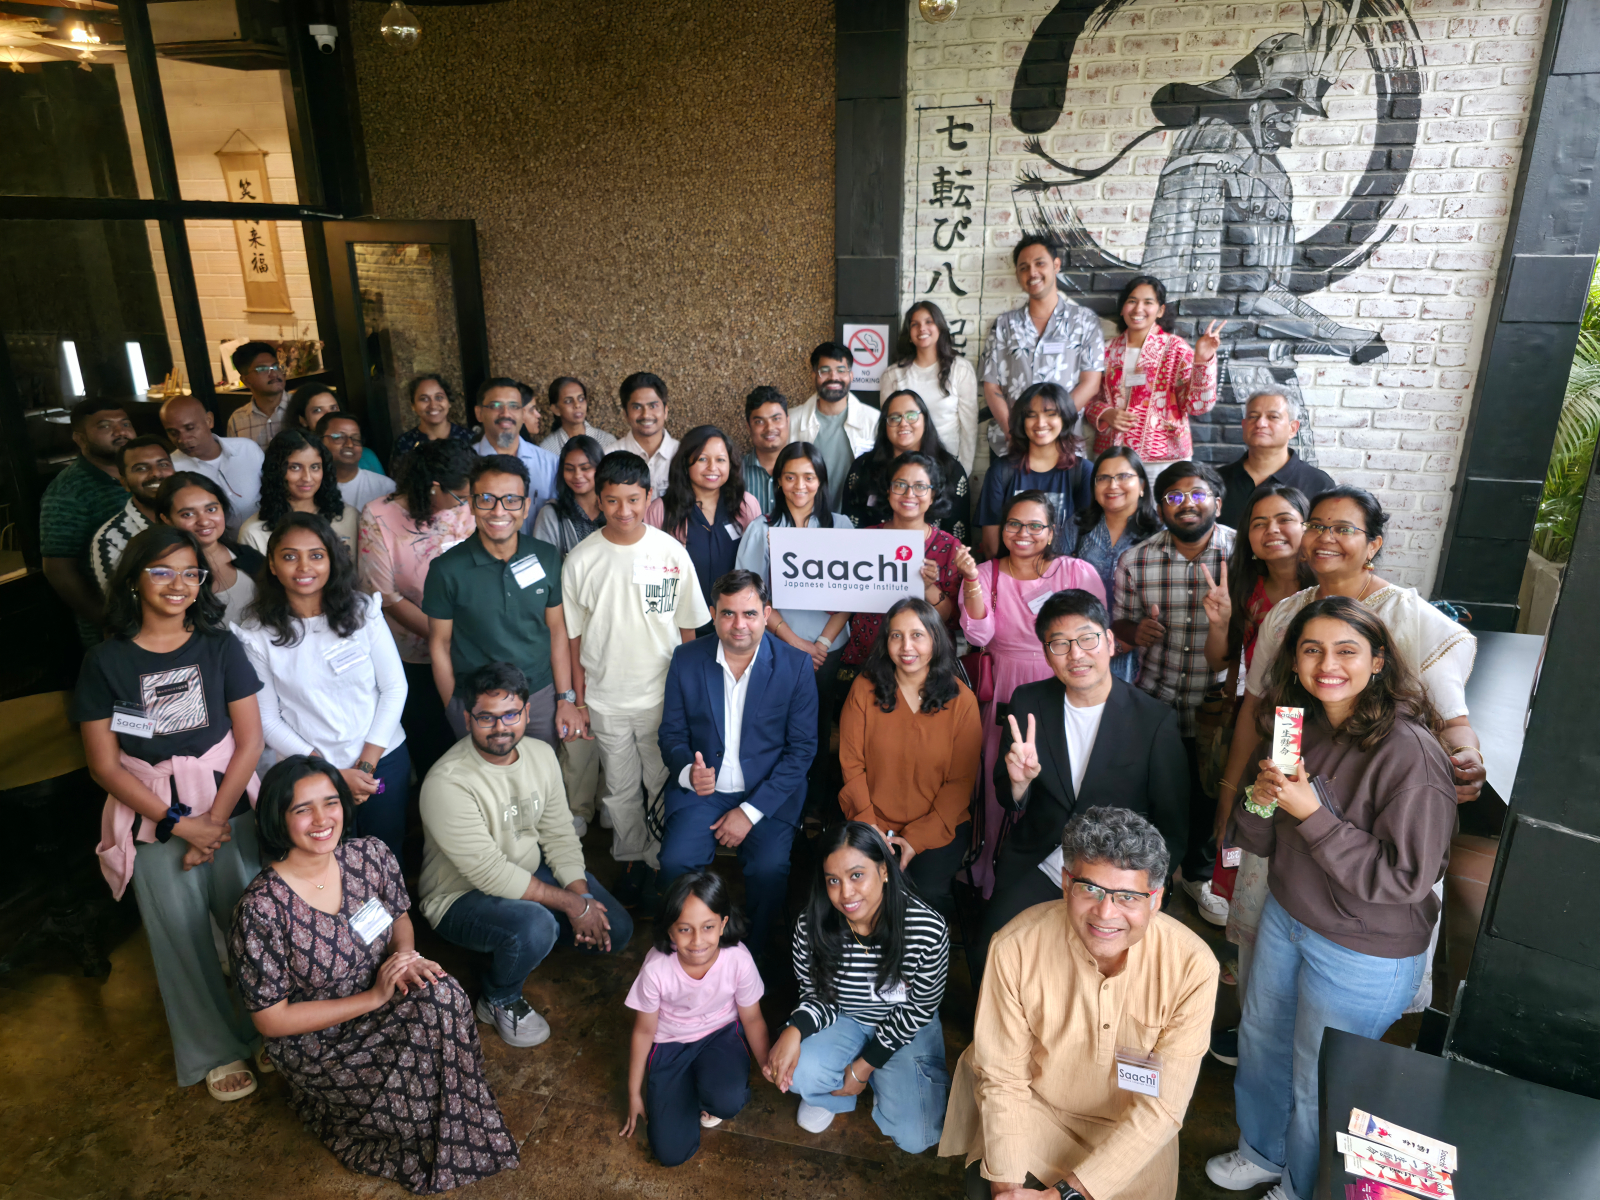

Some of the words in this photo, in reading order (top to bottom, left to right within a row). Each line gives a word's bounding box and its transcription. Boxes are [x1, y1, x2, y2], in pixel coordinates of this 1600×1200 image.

[239, 178, 269, 274] 笑来福
[782, 551, 908, 583] Saachi
[784, 580, 824, 588] Japanese
[827, 582, 870, 591] Language
[873, 583, 909, 591] Institute
[116, 718, 153, 731] Saachi
[1119, 1068, 1156, 1086] Saachi
